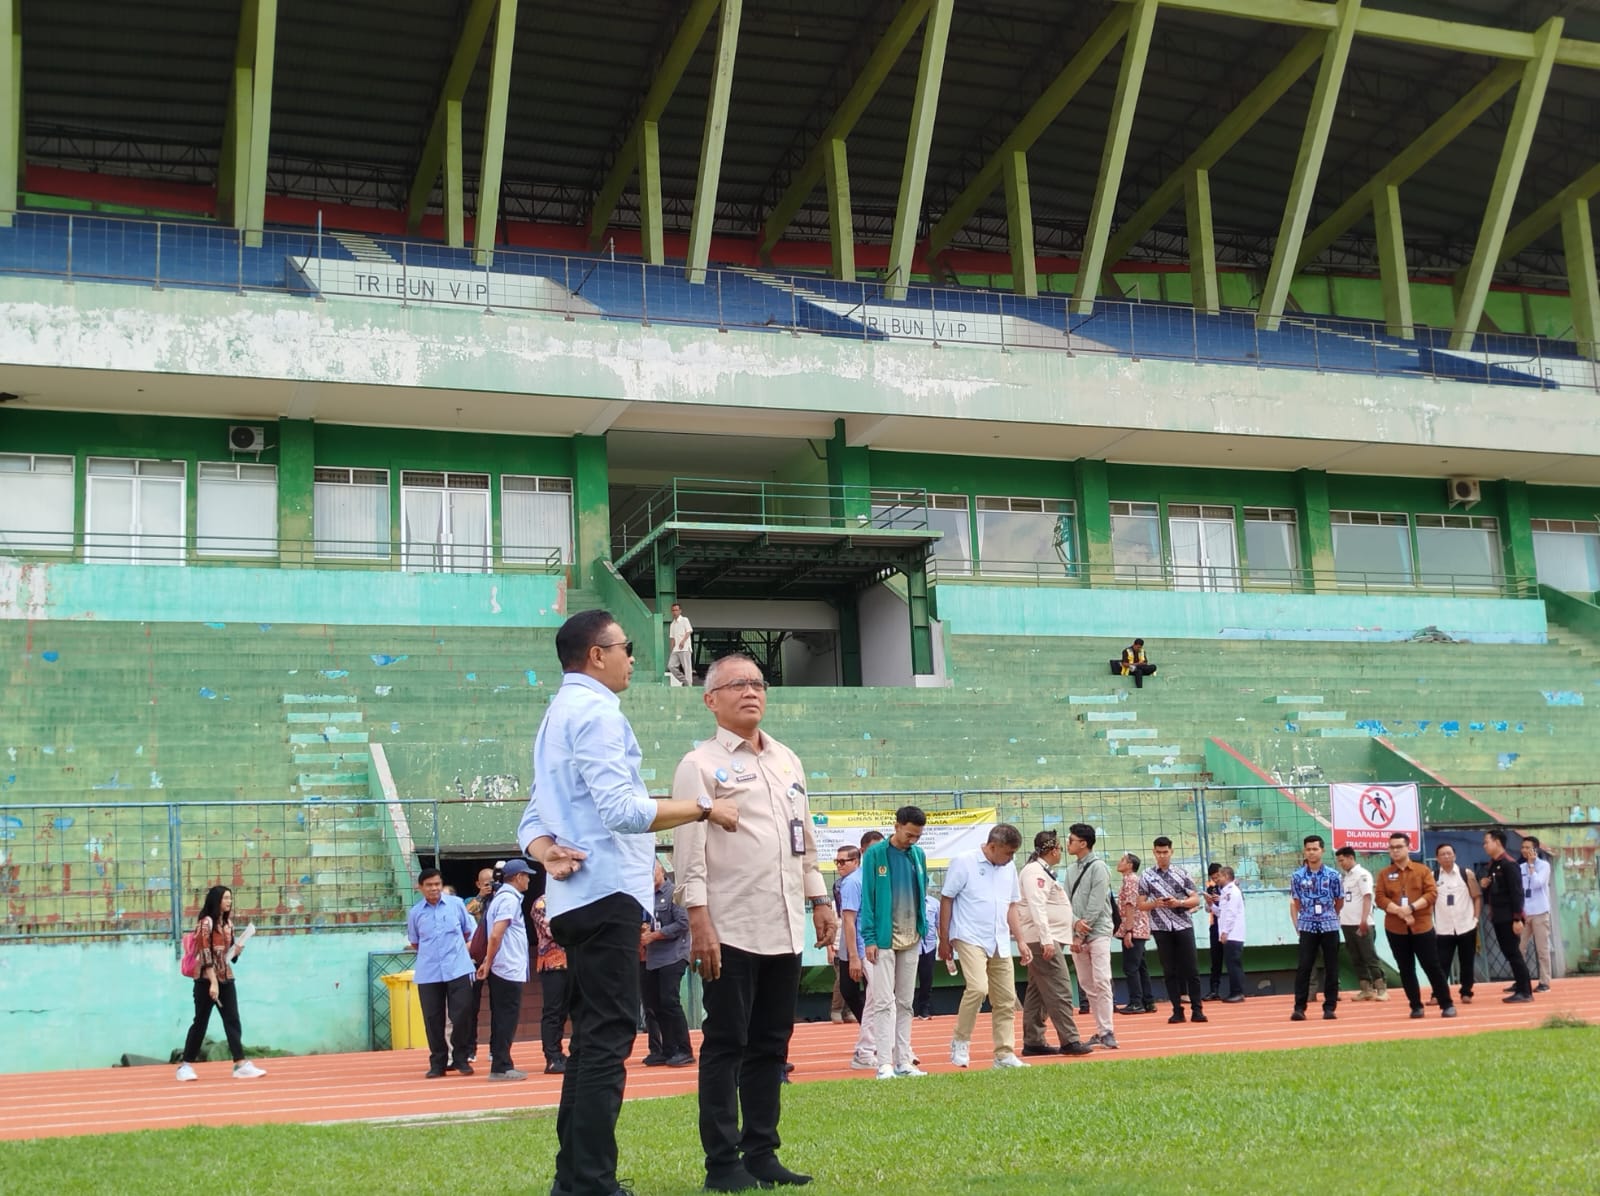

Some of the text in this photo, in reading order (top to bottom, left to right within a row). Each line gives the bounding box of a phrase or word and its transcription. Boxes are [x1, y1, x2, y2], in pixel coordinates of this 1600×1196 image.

[355, 274, 487, 300] TRIBUN VIP
[935, 322, 967, 338] VIP
